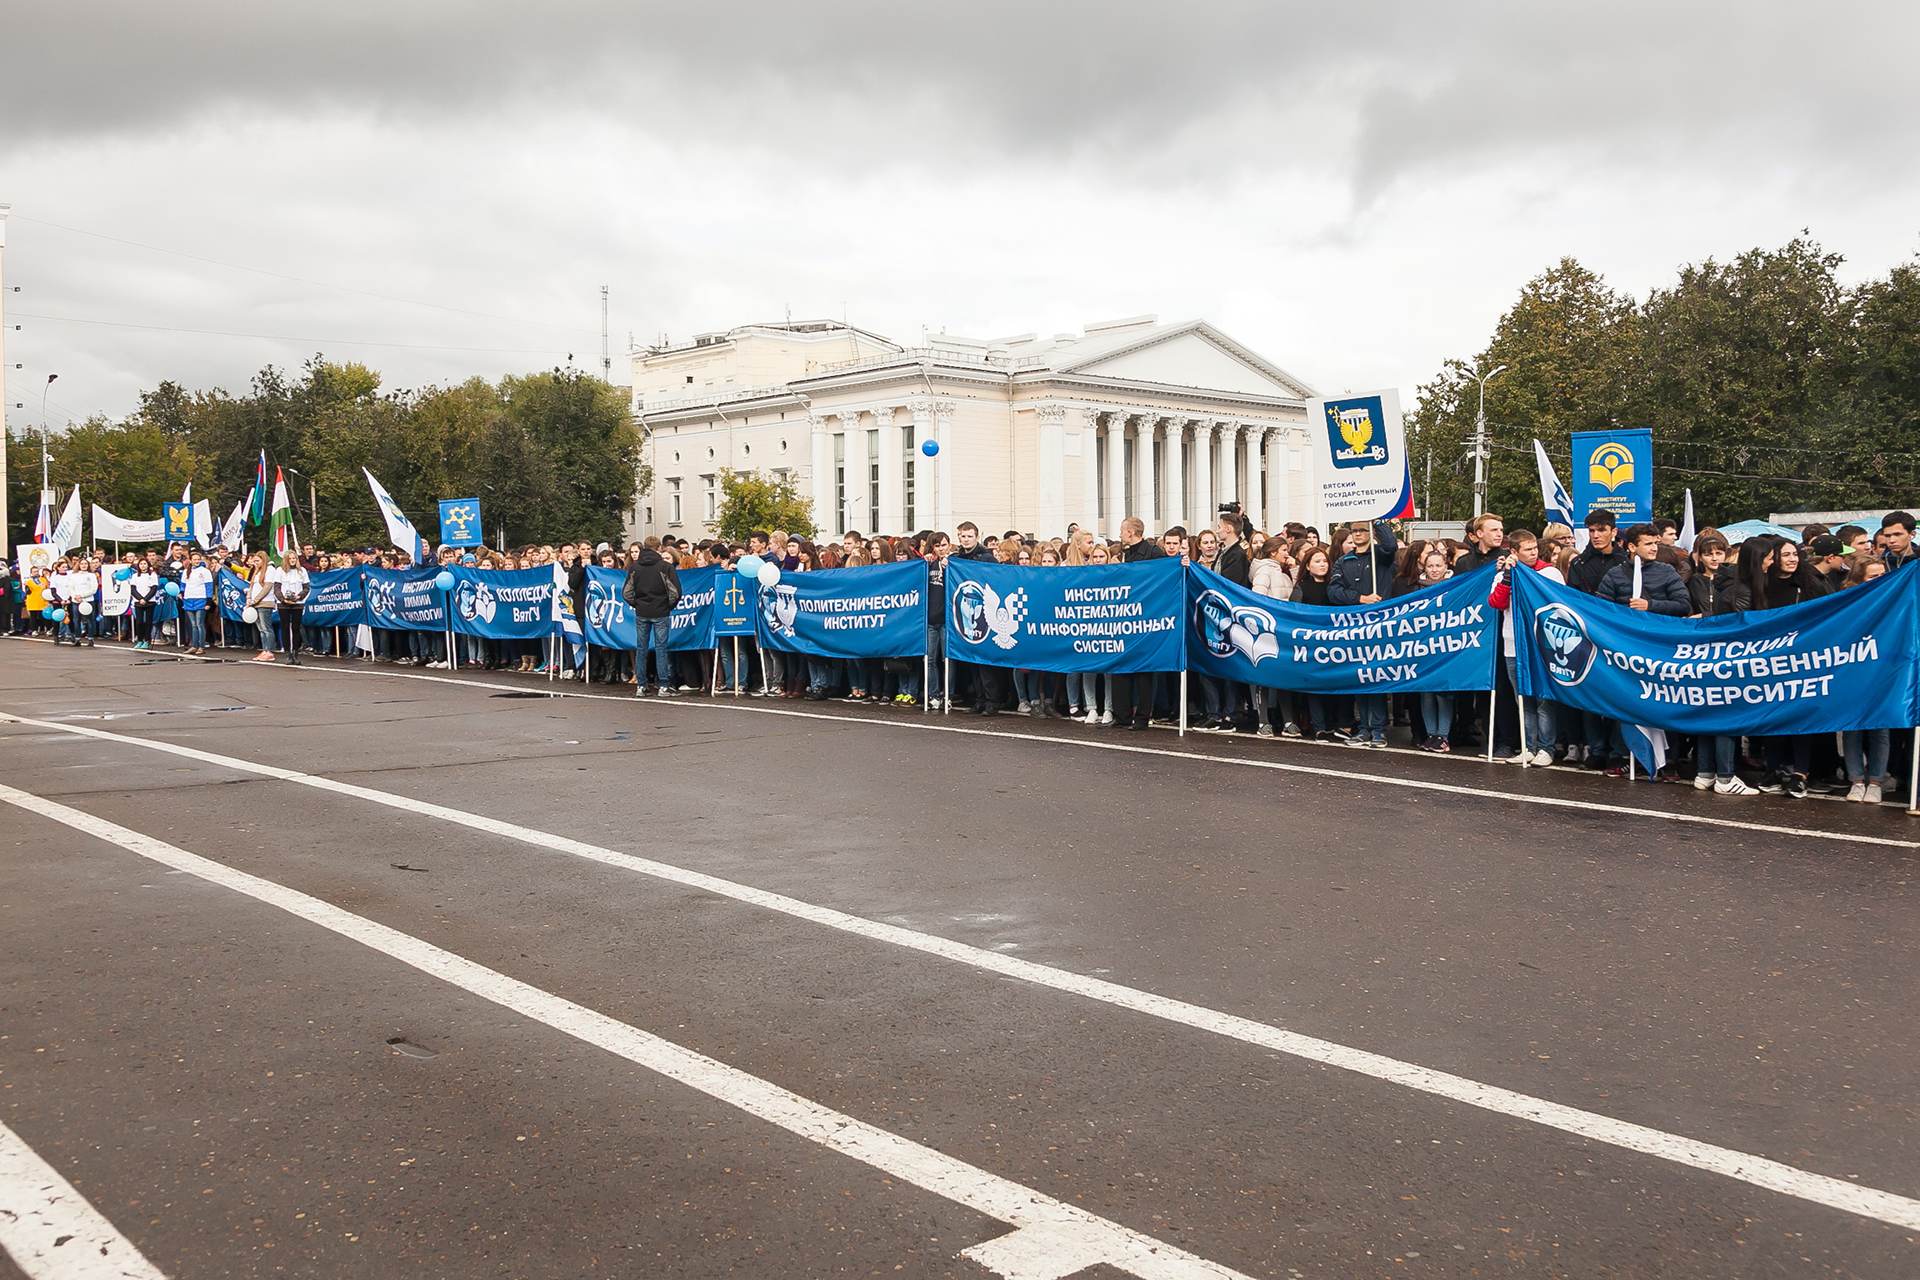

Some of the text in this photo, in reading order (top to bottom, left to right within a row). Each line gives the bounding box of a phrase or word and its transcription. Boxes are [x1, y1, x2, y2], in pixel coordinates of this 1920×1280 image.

[1323, 481, 1356, 489] ВЯТСКИЙ
[1324, 487, 1397, 499] ГОСУДАРСТВЕННЫЙ
[1325, 499, 1376, 508] УНИВЕРСИТЕТ
[317, 592, 351, 602] БИОЛОГИИ
[404, 594, 431, 607] ХИМИИ
[496, 583, 551, 604] КОЛЛЕДЖ
[674, 587, 715, 610] ЕСКИЙ
[799, 589, 919, 613] ПОЛИТЕХНИЧЕСКИЙ
[1064, 585, 1131, 602] ИНСТИТУТ
[513, 606, 540, 622] ВятГУ
[1054, 602, 1143, 619] МАТЕМАТИКИ
[669, 612, 697, 629] ИТУТ
[823, 613, 887, 630] ИНСТИТУТ
[1027, 616, 1176, 638] И ИНФОРМАЦИОННЫХ
[1292, 604, 1484, 640] ГУМАНИТАРНЫХ
[1073, 639, 1125, 653] СИСТЕМ
[1207, 638, 1230, 652] ВятГУ
[1293, 630, 1482, 664] И СОЦИАЛЬНЫХ
[1673, 630, 1798, 660] ВЯТСКИЙ
[1602, 634, 1878, 682] ГОСУДАРСТВЕННЫЙ
[1357, 663, 1418, 684] НАУК
[1549, 662, 1576, 679] ВятГУ
[1639, 674, 1834, 706] УНИВЕРСИТЕТ
